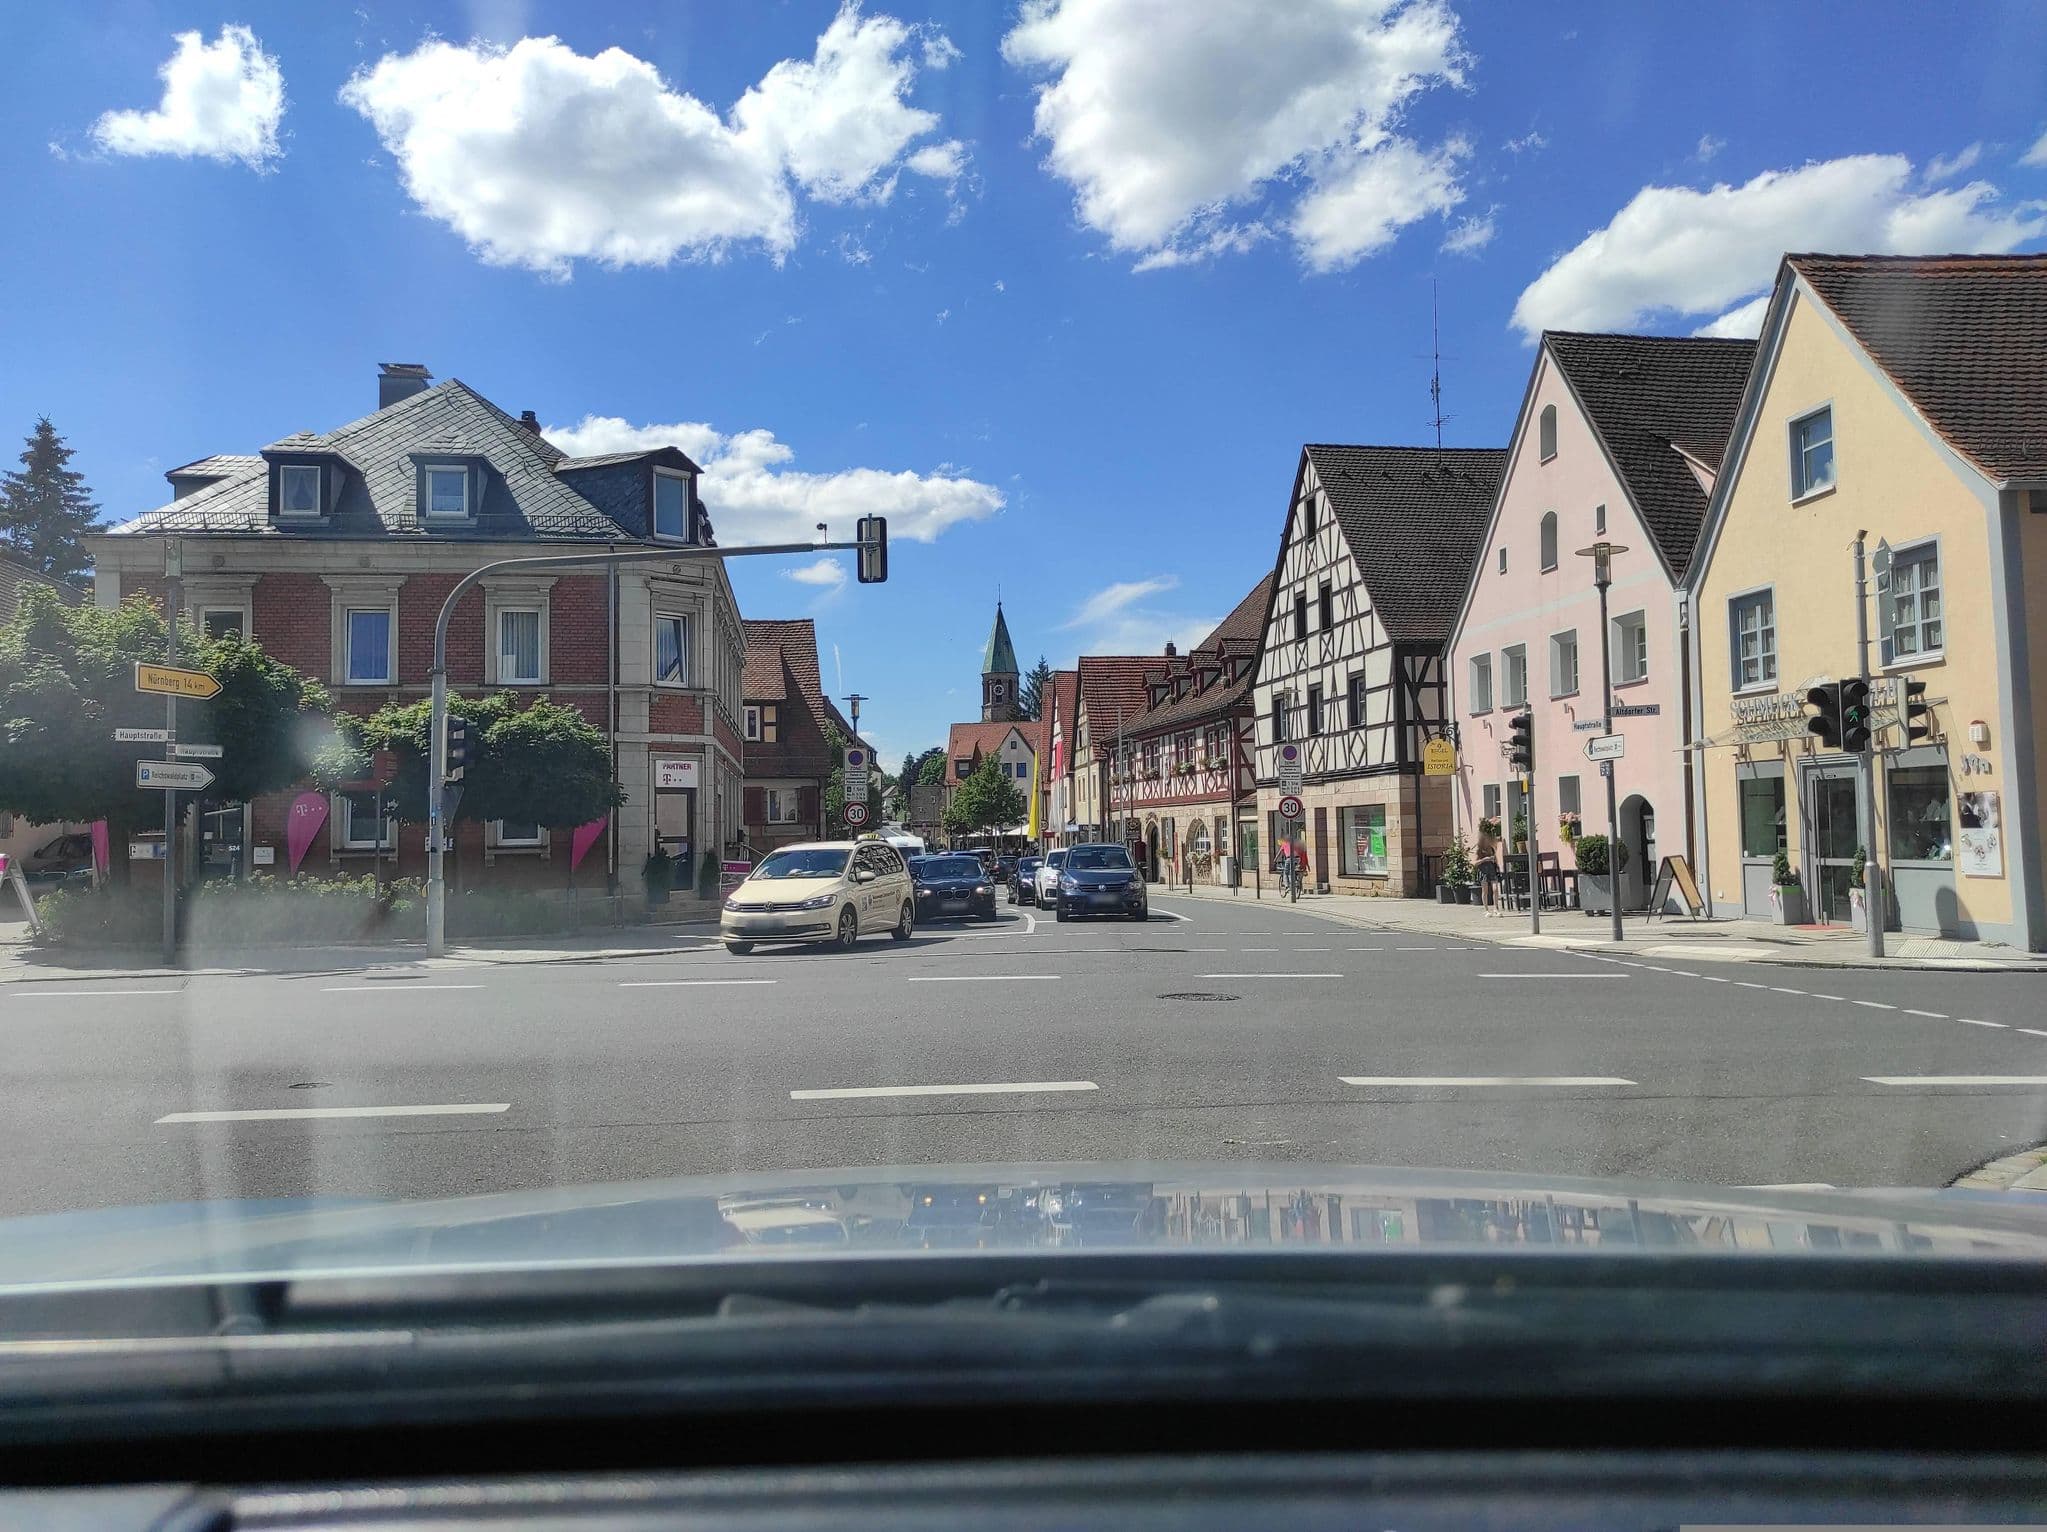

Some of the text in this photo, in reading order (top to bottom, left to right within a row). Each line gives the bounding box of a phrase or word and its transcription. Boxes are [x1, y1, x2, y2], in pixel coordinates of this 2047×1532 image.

[148, 673, 205, 690] Nürnberg 14 km
[1615, 706, 1658, 716] Altdorfer Str.
[119, 731, 163, 740] Hauptstraße
[1283, 802, 1297, 813] 30
[850, 808, 864, 820] 30
